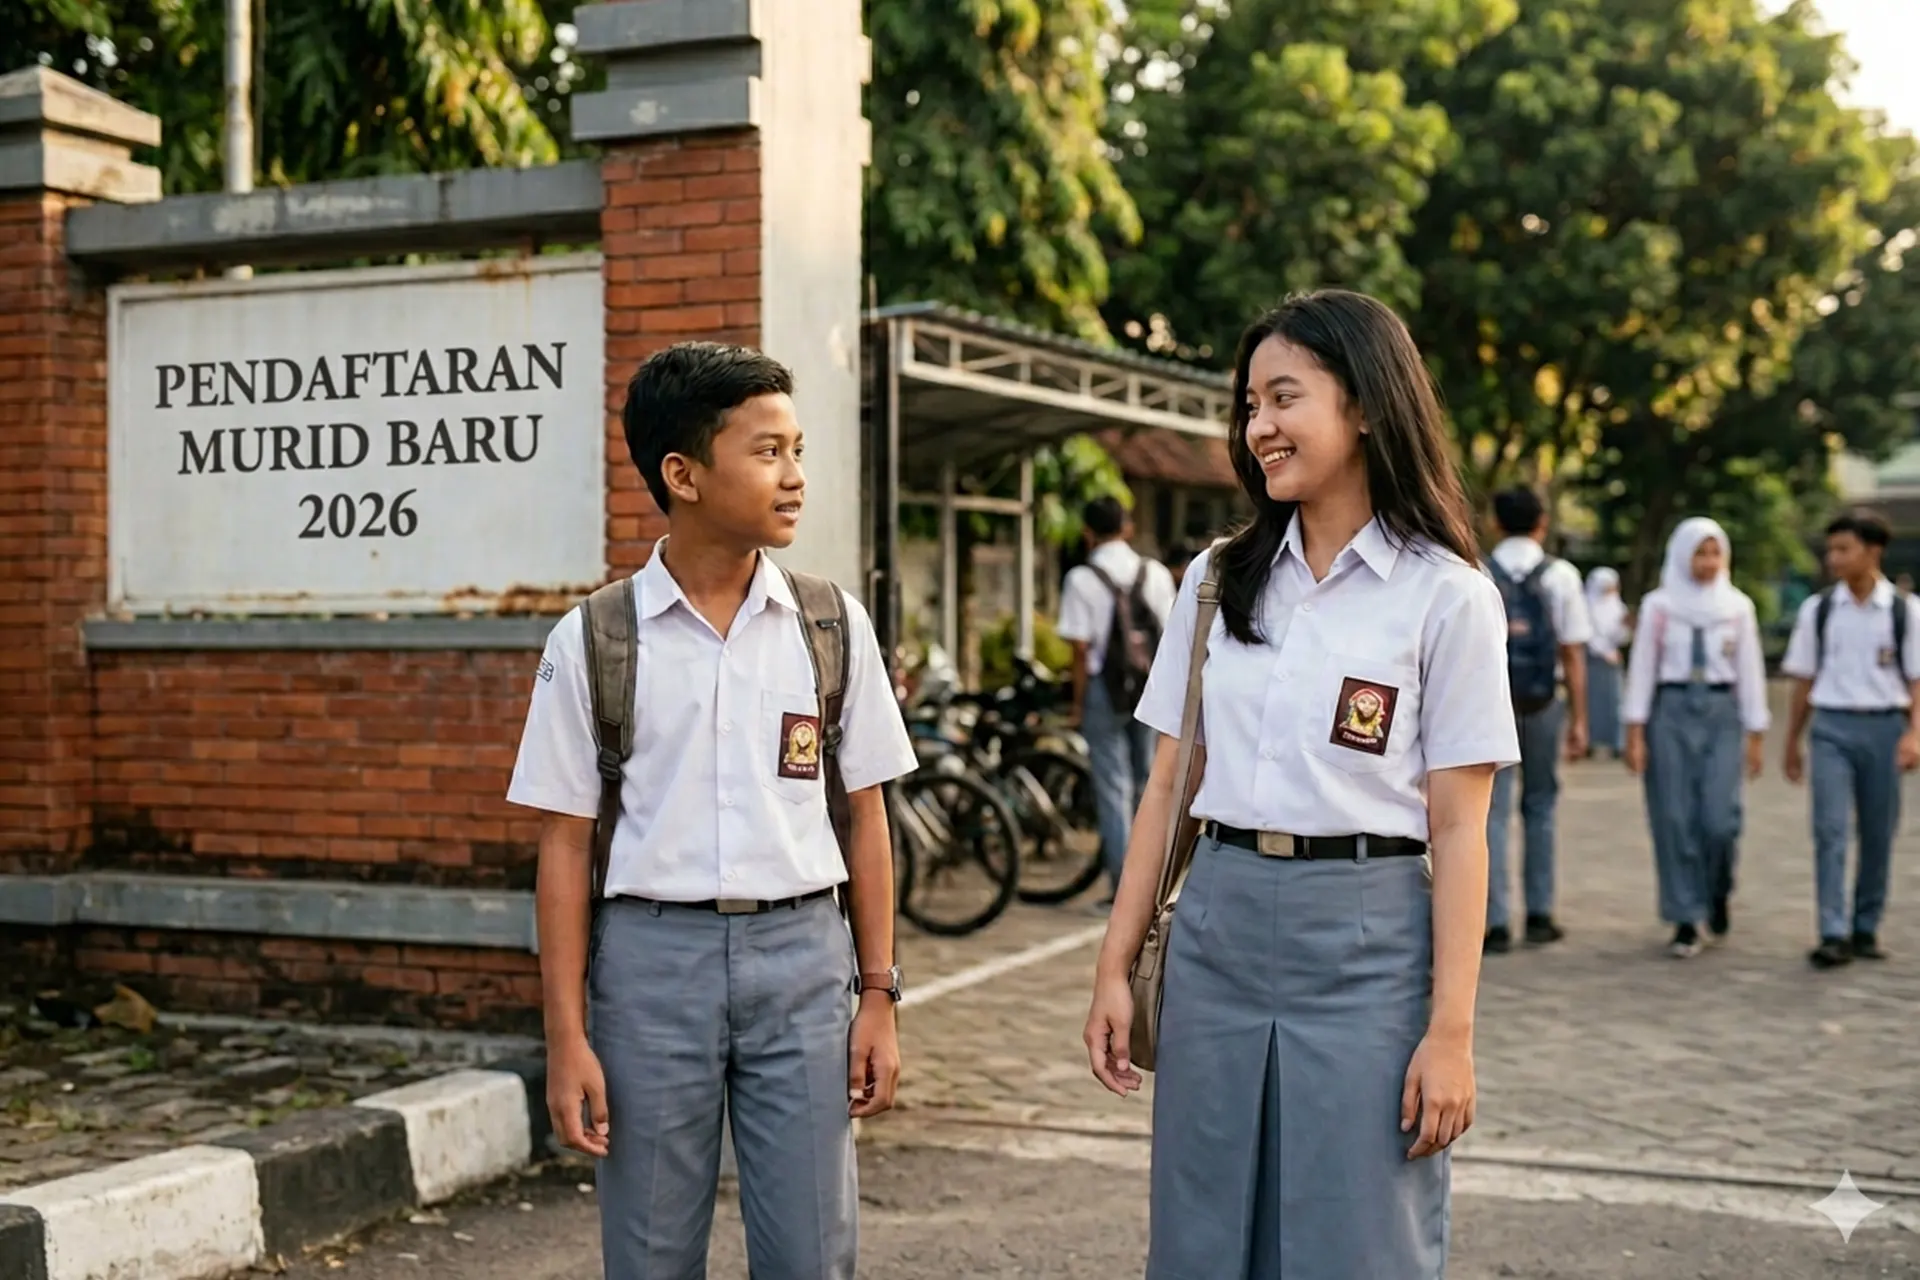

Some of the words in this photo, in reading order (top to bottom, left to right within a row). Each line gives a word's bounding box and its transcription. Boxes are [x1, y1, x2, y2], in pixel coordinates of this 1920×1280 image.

[155, 342, 567, 408] PENDAFTARAN
[178, 423, 370, 475] MURID
[386, 415, 543, 467] BARU
[298, 489, 418, 539] 2026
